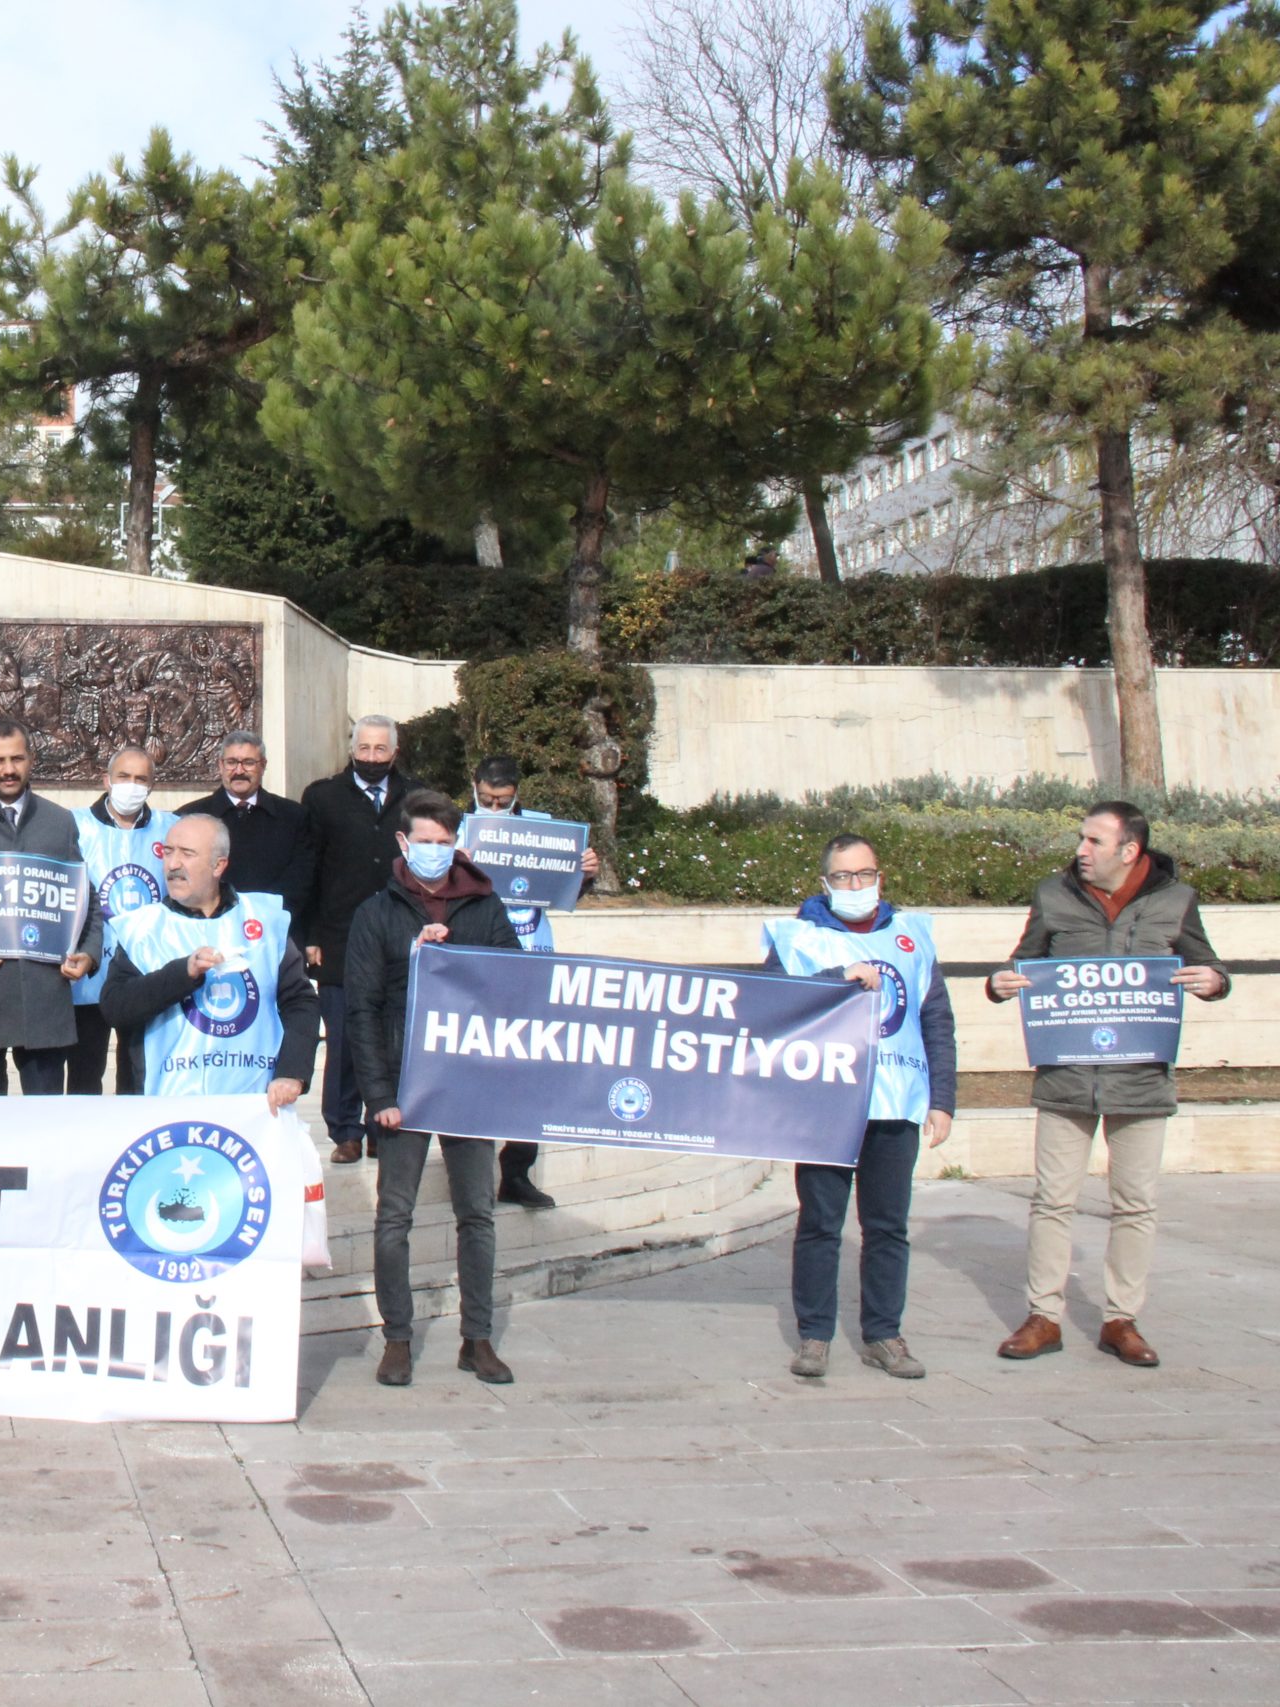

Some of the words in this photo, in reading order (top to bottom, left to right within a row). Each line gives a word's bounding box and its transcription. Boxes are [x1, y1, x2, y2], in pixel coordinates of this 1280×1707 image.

[479, 828, 510, 845] GELİR
[511, 830, 576, 852] DAĞILIMINDA
[473, 850, 513, 867] ADALET
[513, 853, 577, 873] SAĞLANMALI
[23, 866, 68, 884] ORANLARI
[515, 924, 535, 934] 1992
[1055, 962, 1146, 989] 3600
[548, 964, 739, 1020] MEMUR
[1029, 994, 1058, 1010] EK
[1063, 990, 1176, 1008] GÖSTERGE
[210, 1023, 236, 1035] 1992
[423, 1010, 634, 1067] HAKKINI
[650, 1019, 858, 1084] İSTİYOR
[542, 1124, 576, 1133] TÜRKİYE
[101, 1130, 175, 1239] TÜRKİYE
[187, 1127, 266, 1247] KAMU-SEN
[158, 1259, 201, 1280] 1992
